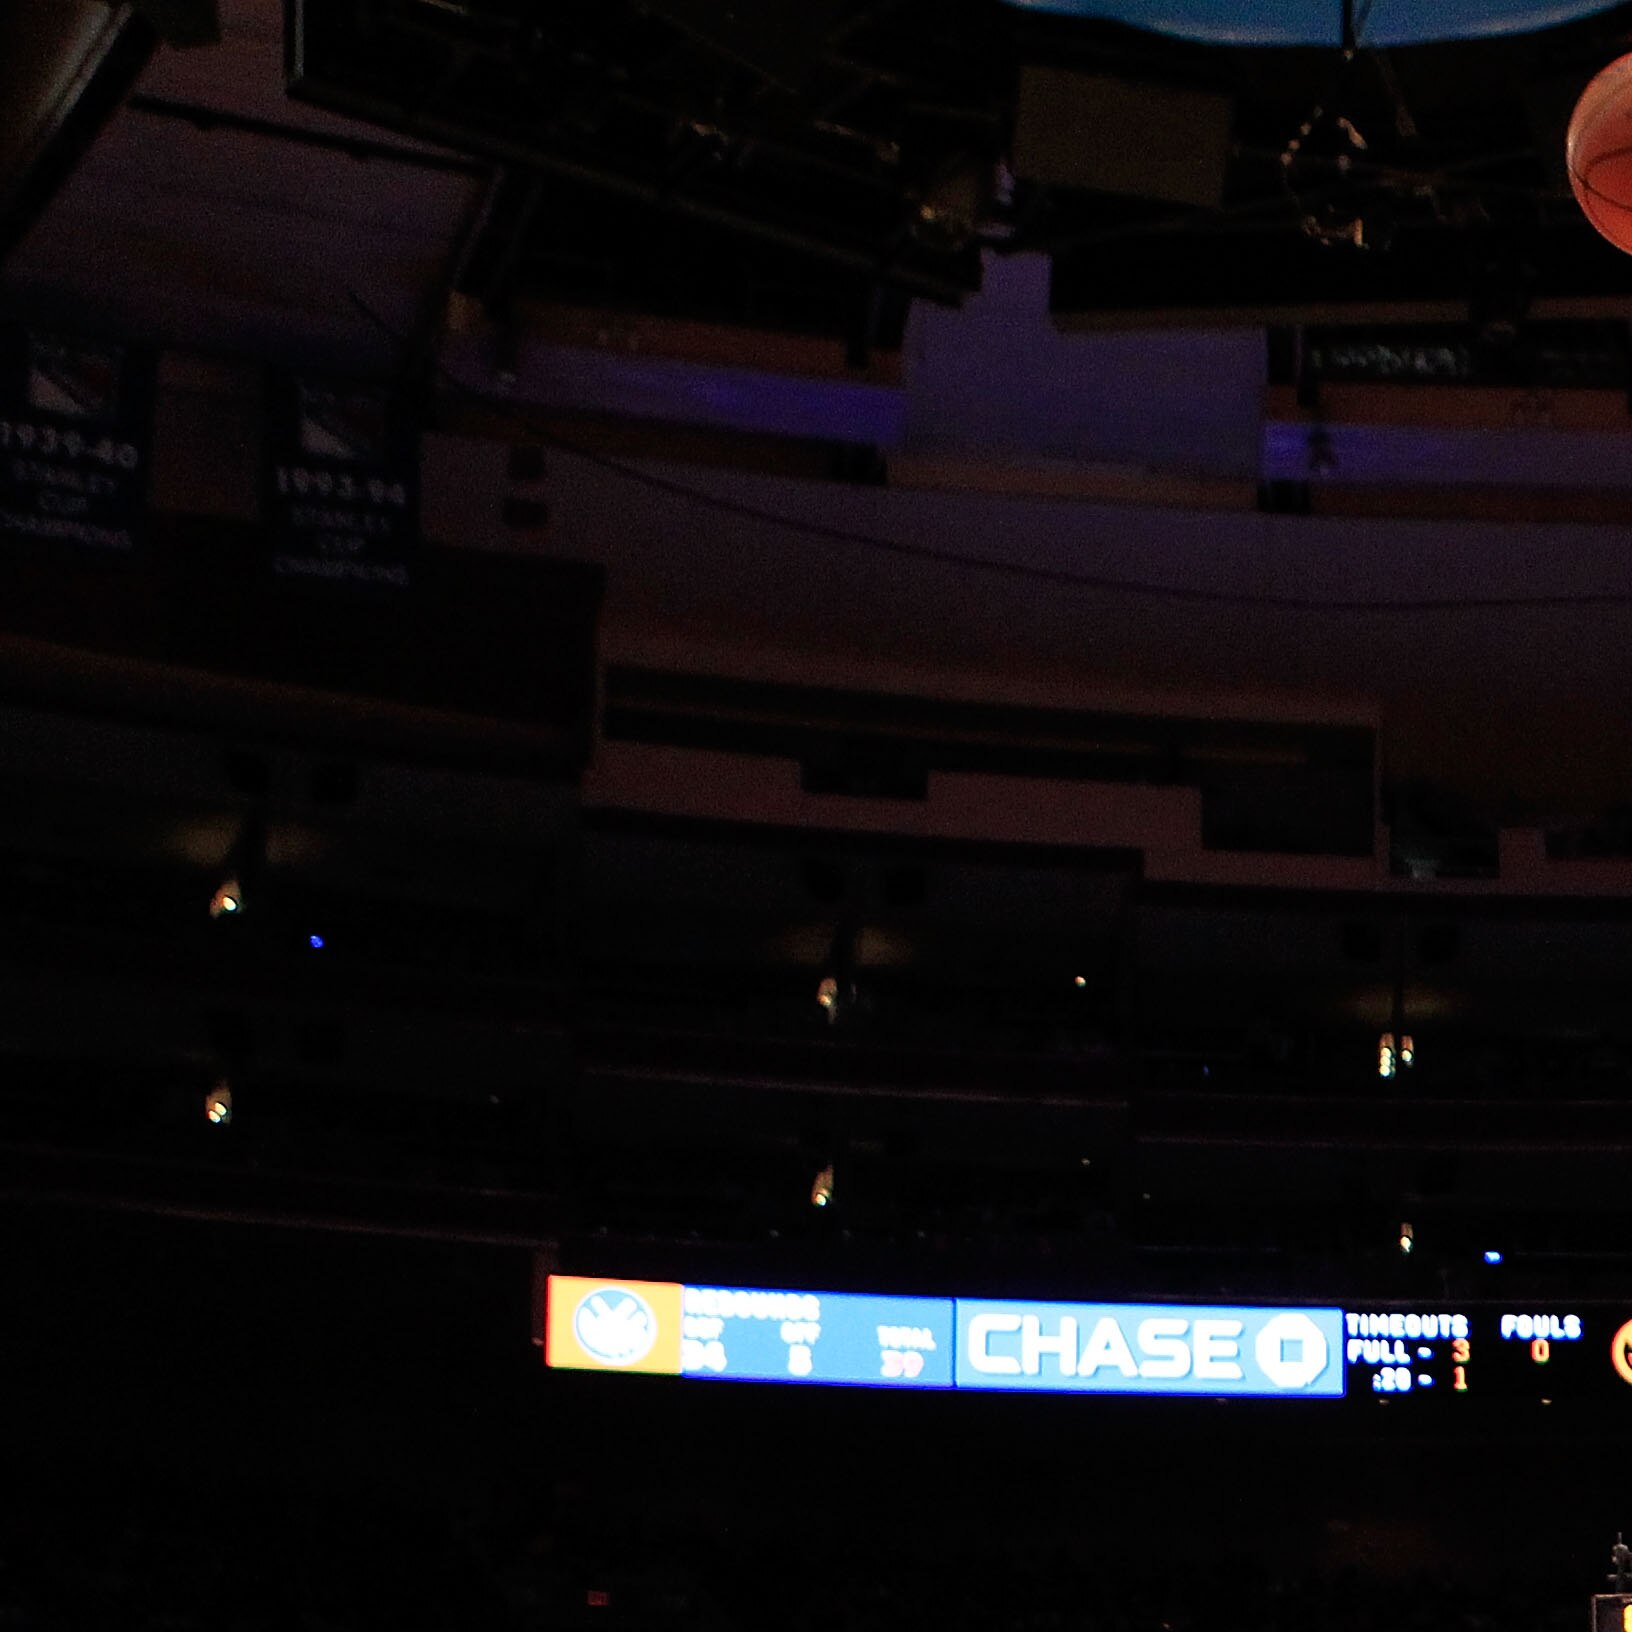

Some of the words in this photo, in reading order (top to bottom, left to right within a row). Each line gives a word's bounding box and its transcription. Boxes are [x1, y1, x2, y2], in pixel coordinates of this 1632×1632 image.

[1345, 1313, 1469, 1338] TIMEOUTS
[1501, 1313, 1582, 1339] FOULS
[967, 1313, 1246, 1380] CHASE
[1347, 1338, 1411, 1363] FULL
[1453, 1338, 1470, 1362] 3
[1455, 1366, 1468, 1390] 1
